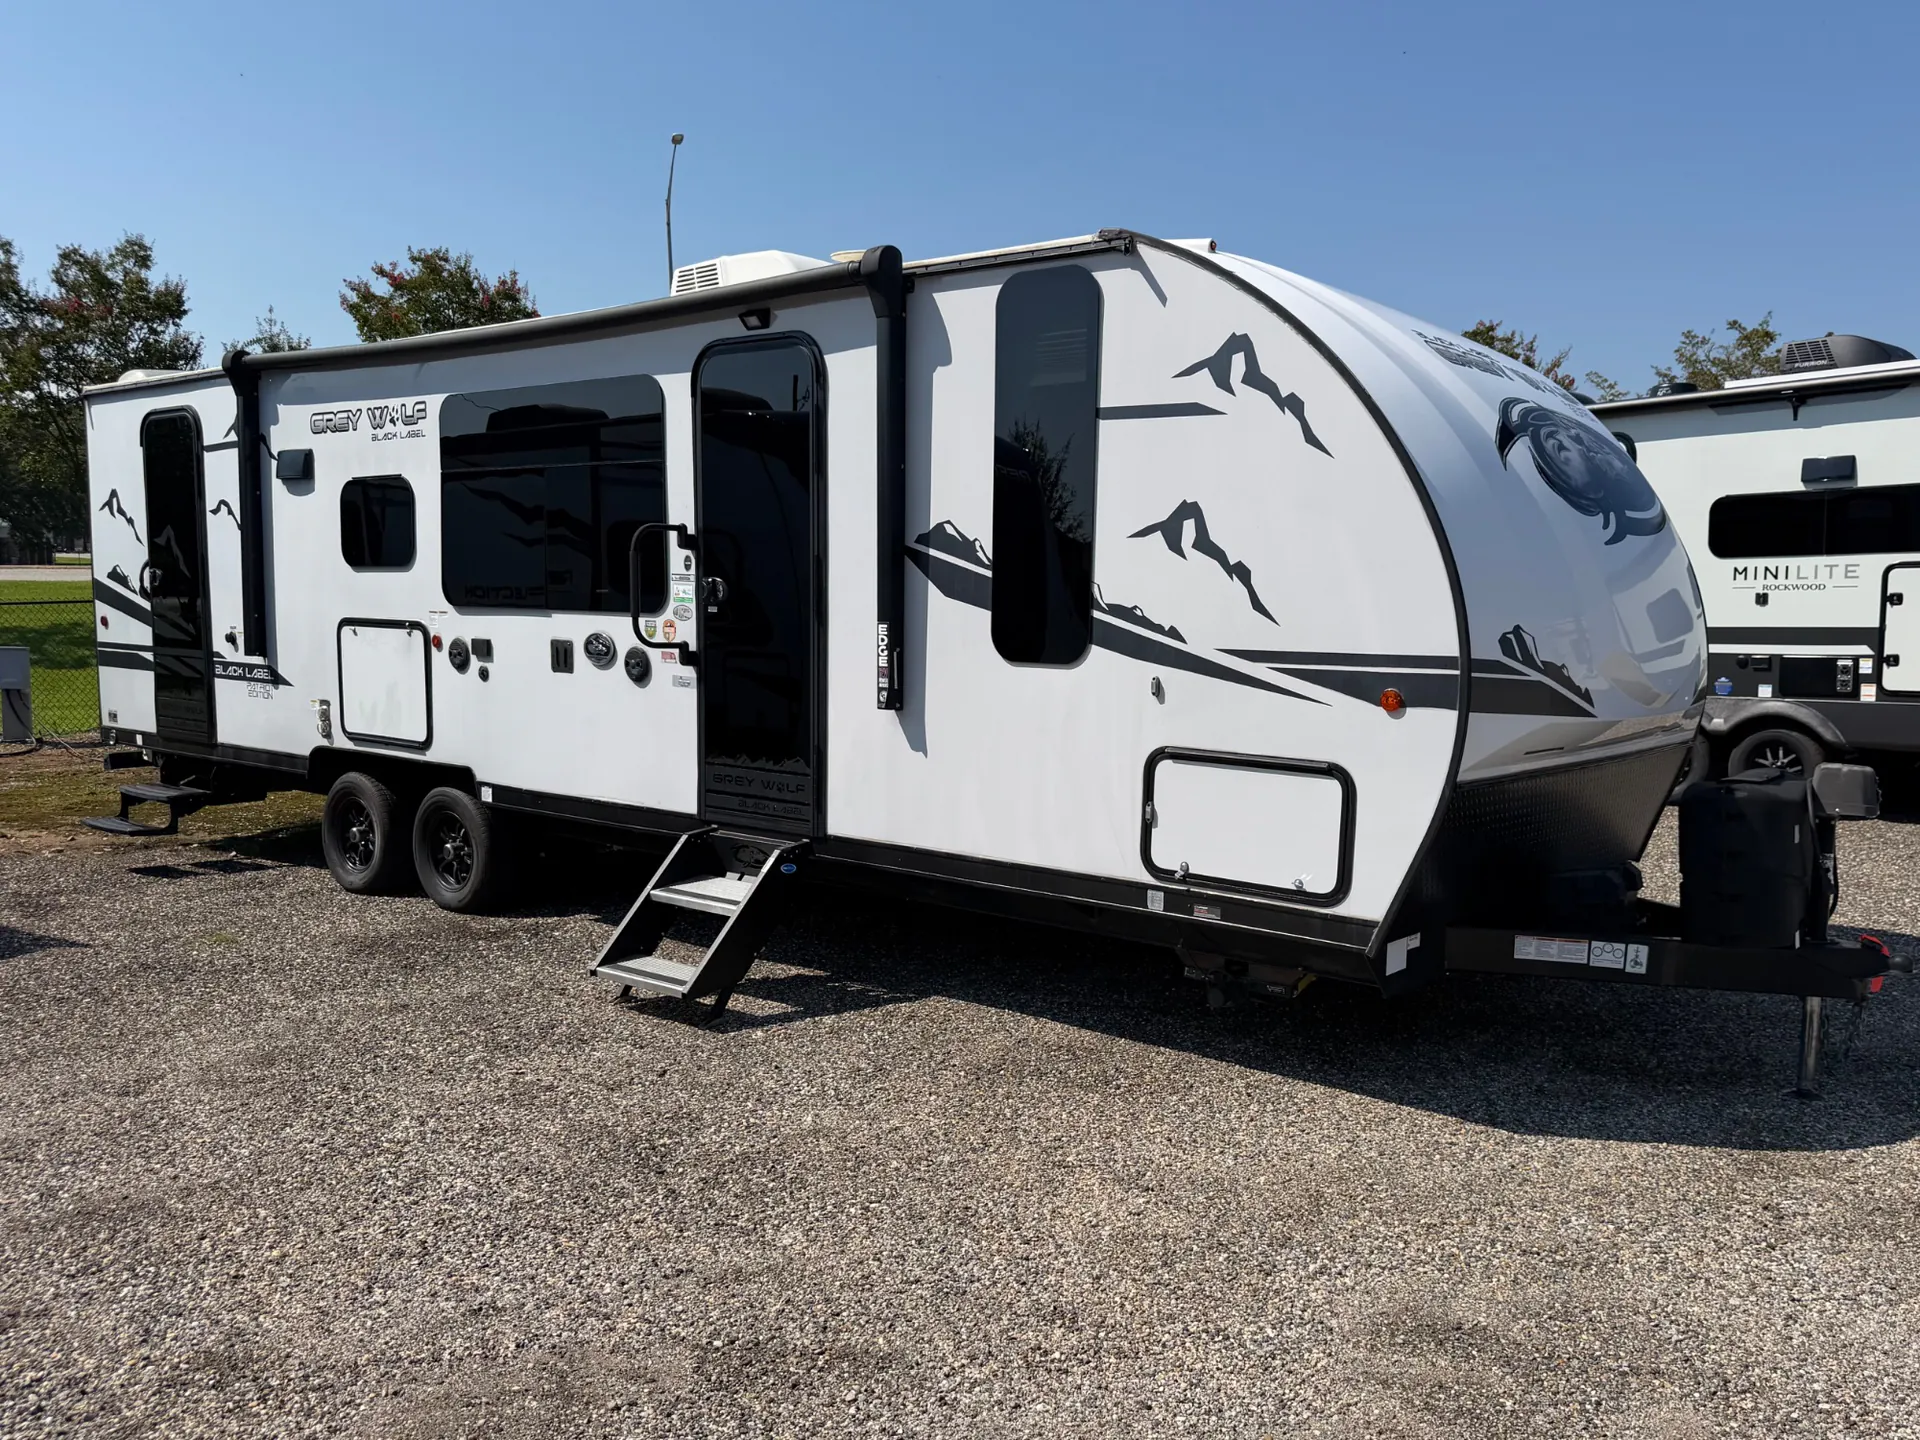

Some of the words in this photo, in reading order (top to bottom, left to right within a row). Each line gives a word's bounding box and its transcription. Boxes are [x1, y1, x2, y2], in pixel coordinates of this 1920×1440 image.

[310, 409, 363, 434] GREY
[371, 431, 398, 442] BLACK
[399, 429, 426, 439] LABEL
[1762, 583, 1827, 591] ROCKWOOD
[878, 624, 888, 667] EDGE
[215, 664, 244, 677] BLACK
[245, 667, 274, 680] LABEL
[248, 690, 274, 700] EDITION
[712, 773, 755, 787] GREY
[738, 798, 771, 810] BLACK
[773, 805, 805, 817] LABEL
